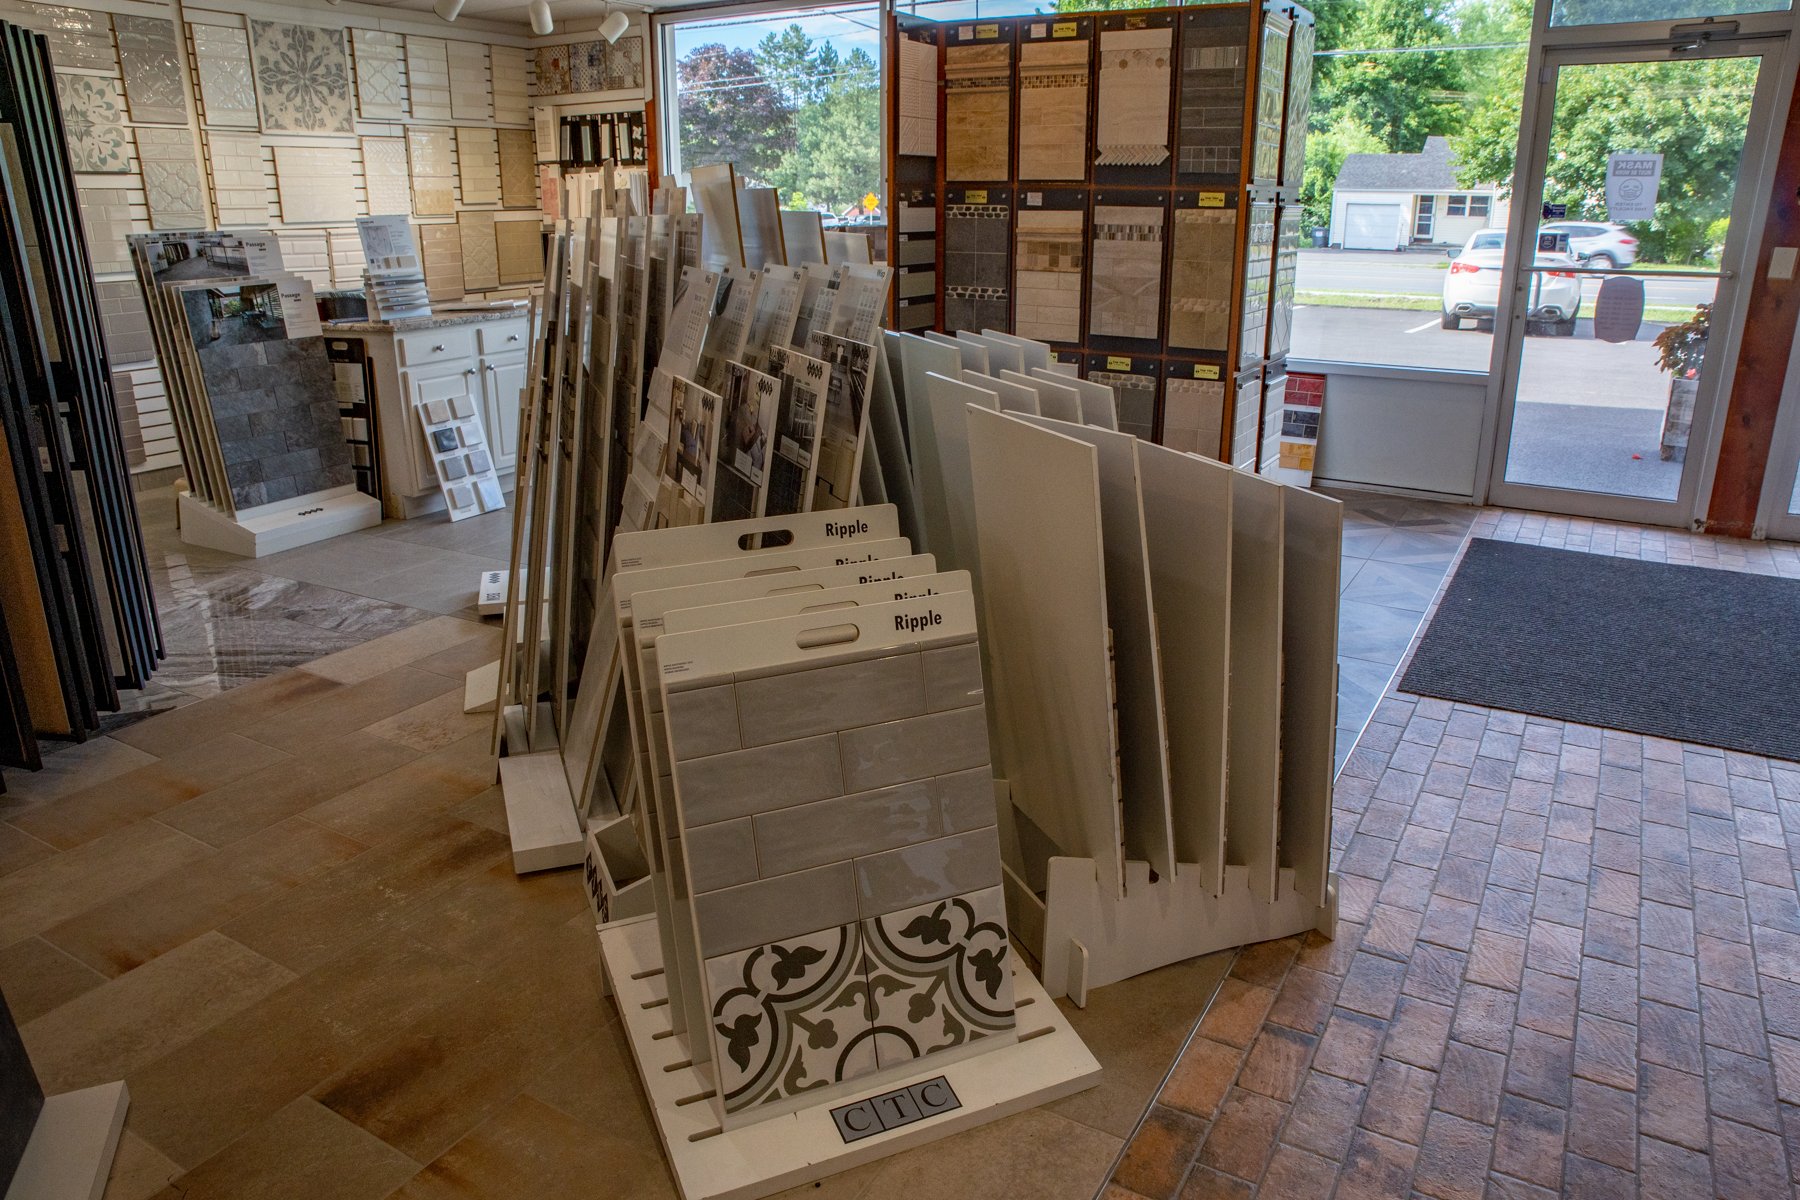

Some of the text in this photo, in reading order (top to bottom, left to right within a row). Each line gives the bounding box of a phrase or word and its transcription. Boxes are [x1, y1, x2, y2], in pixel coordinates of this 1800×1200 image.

[825, 519, 869, 539] Ripple
[894, 609, 943, 633] Ripple
[844, 1083, 948, 1131] CTC
